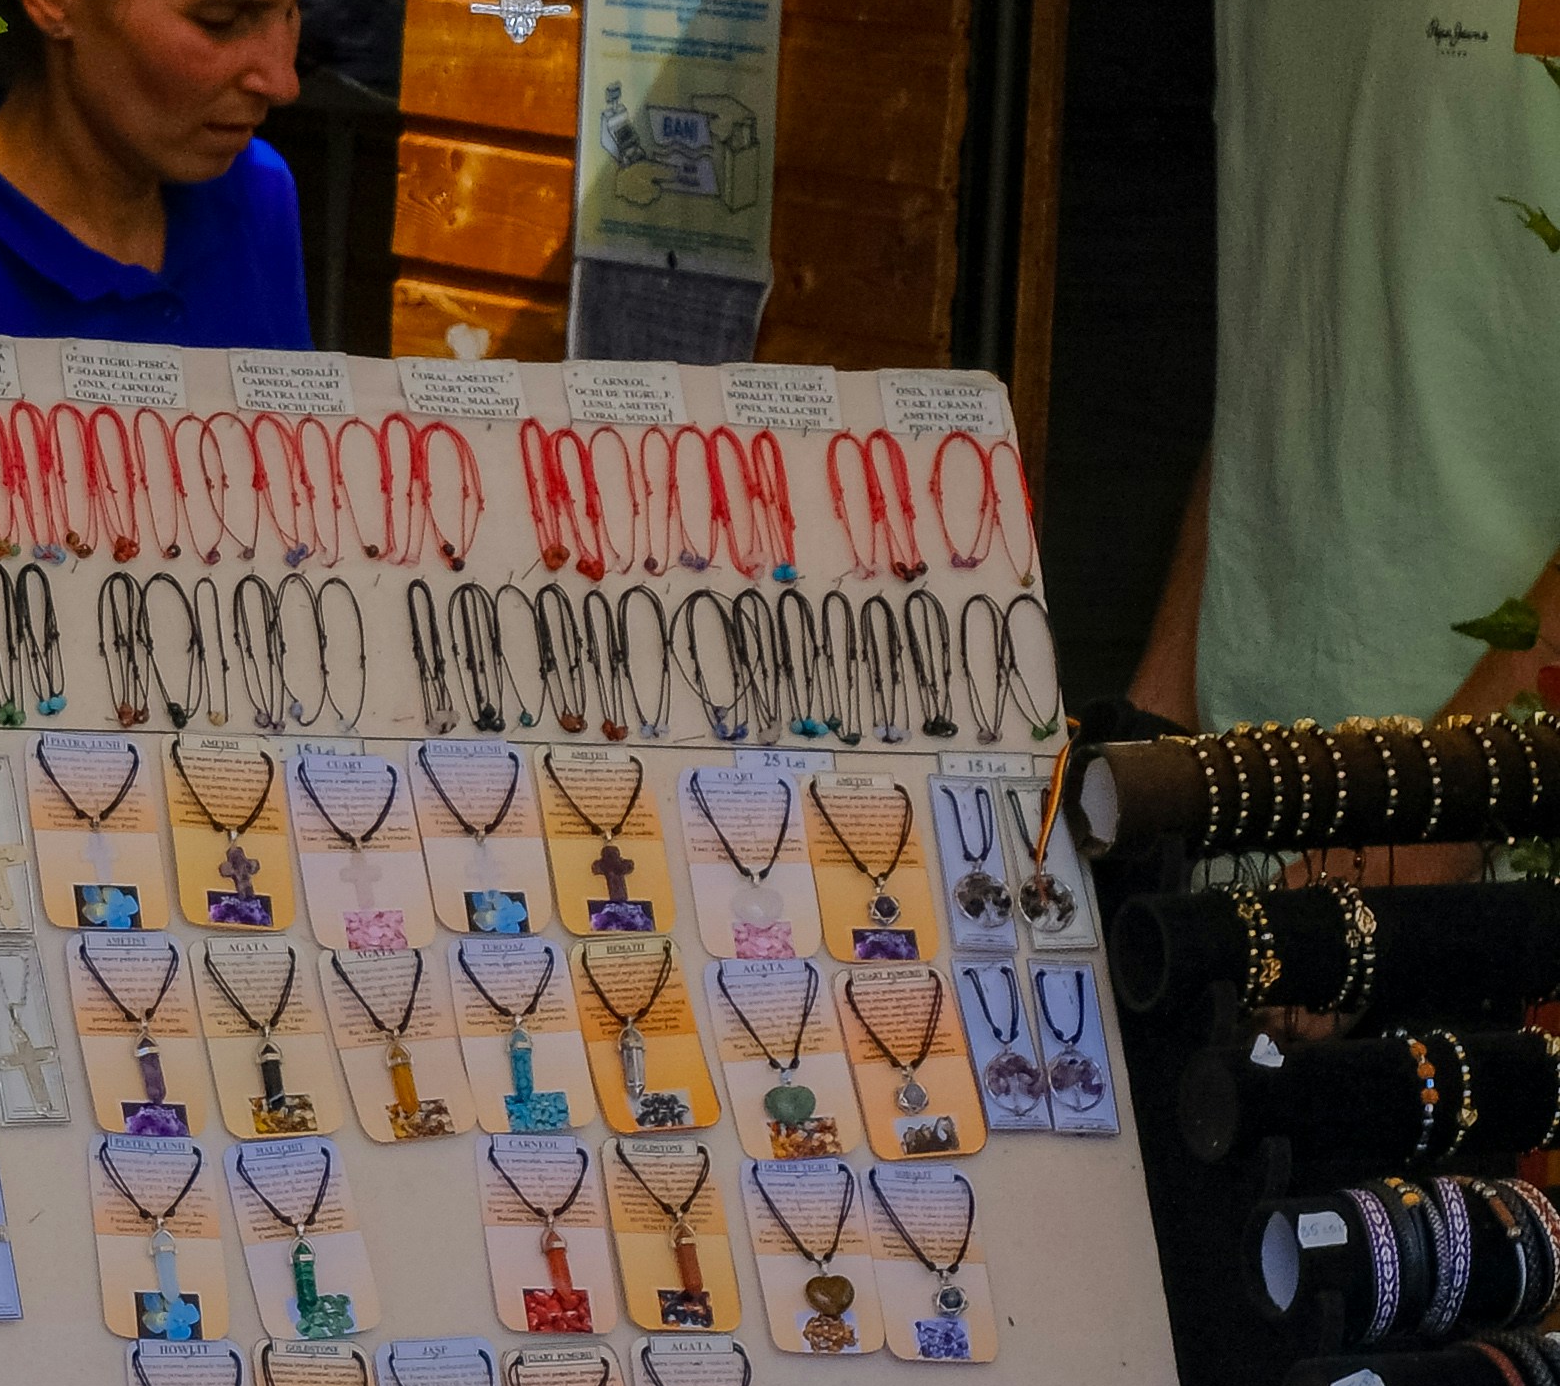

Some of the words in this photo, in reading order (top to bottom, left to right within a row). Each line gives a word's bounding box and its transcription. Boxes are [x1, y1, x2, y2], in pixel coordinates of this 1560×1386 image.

[764, 753, 781, 766] 25
[786, 757, 806, 769] Lei
[969, 760, 984, 772] 15
[988, 762, 1007, 773] Lei
[228, 941, 269, 952] AGATA
[743, 962, 784, 973] AGATA
[115, 1139, 150, 1150] PIATRA
[508, 1140, 559, 1150] CARNEOL
[671, 1342, 713, 1352] AGATA
